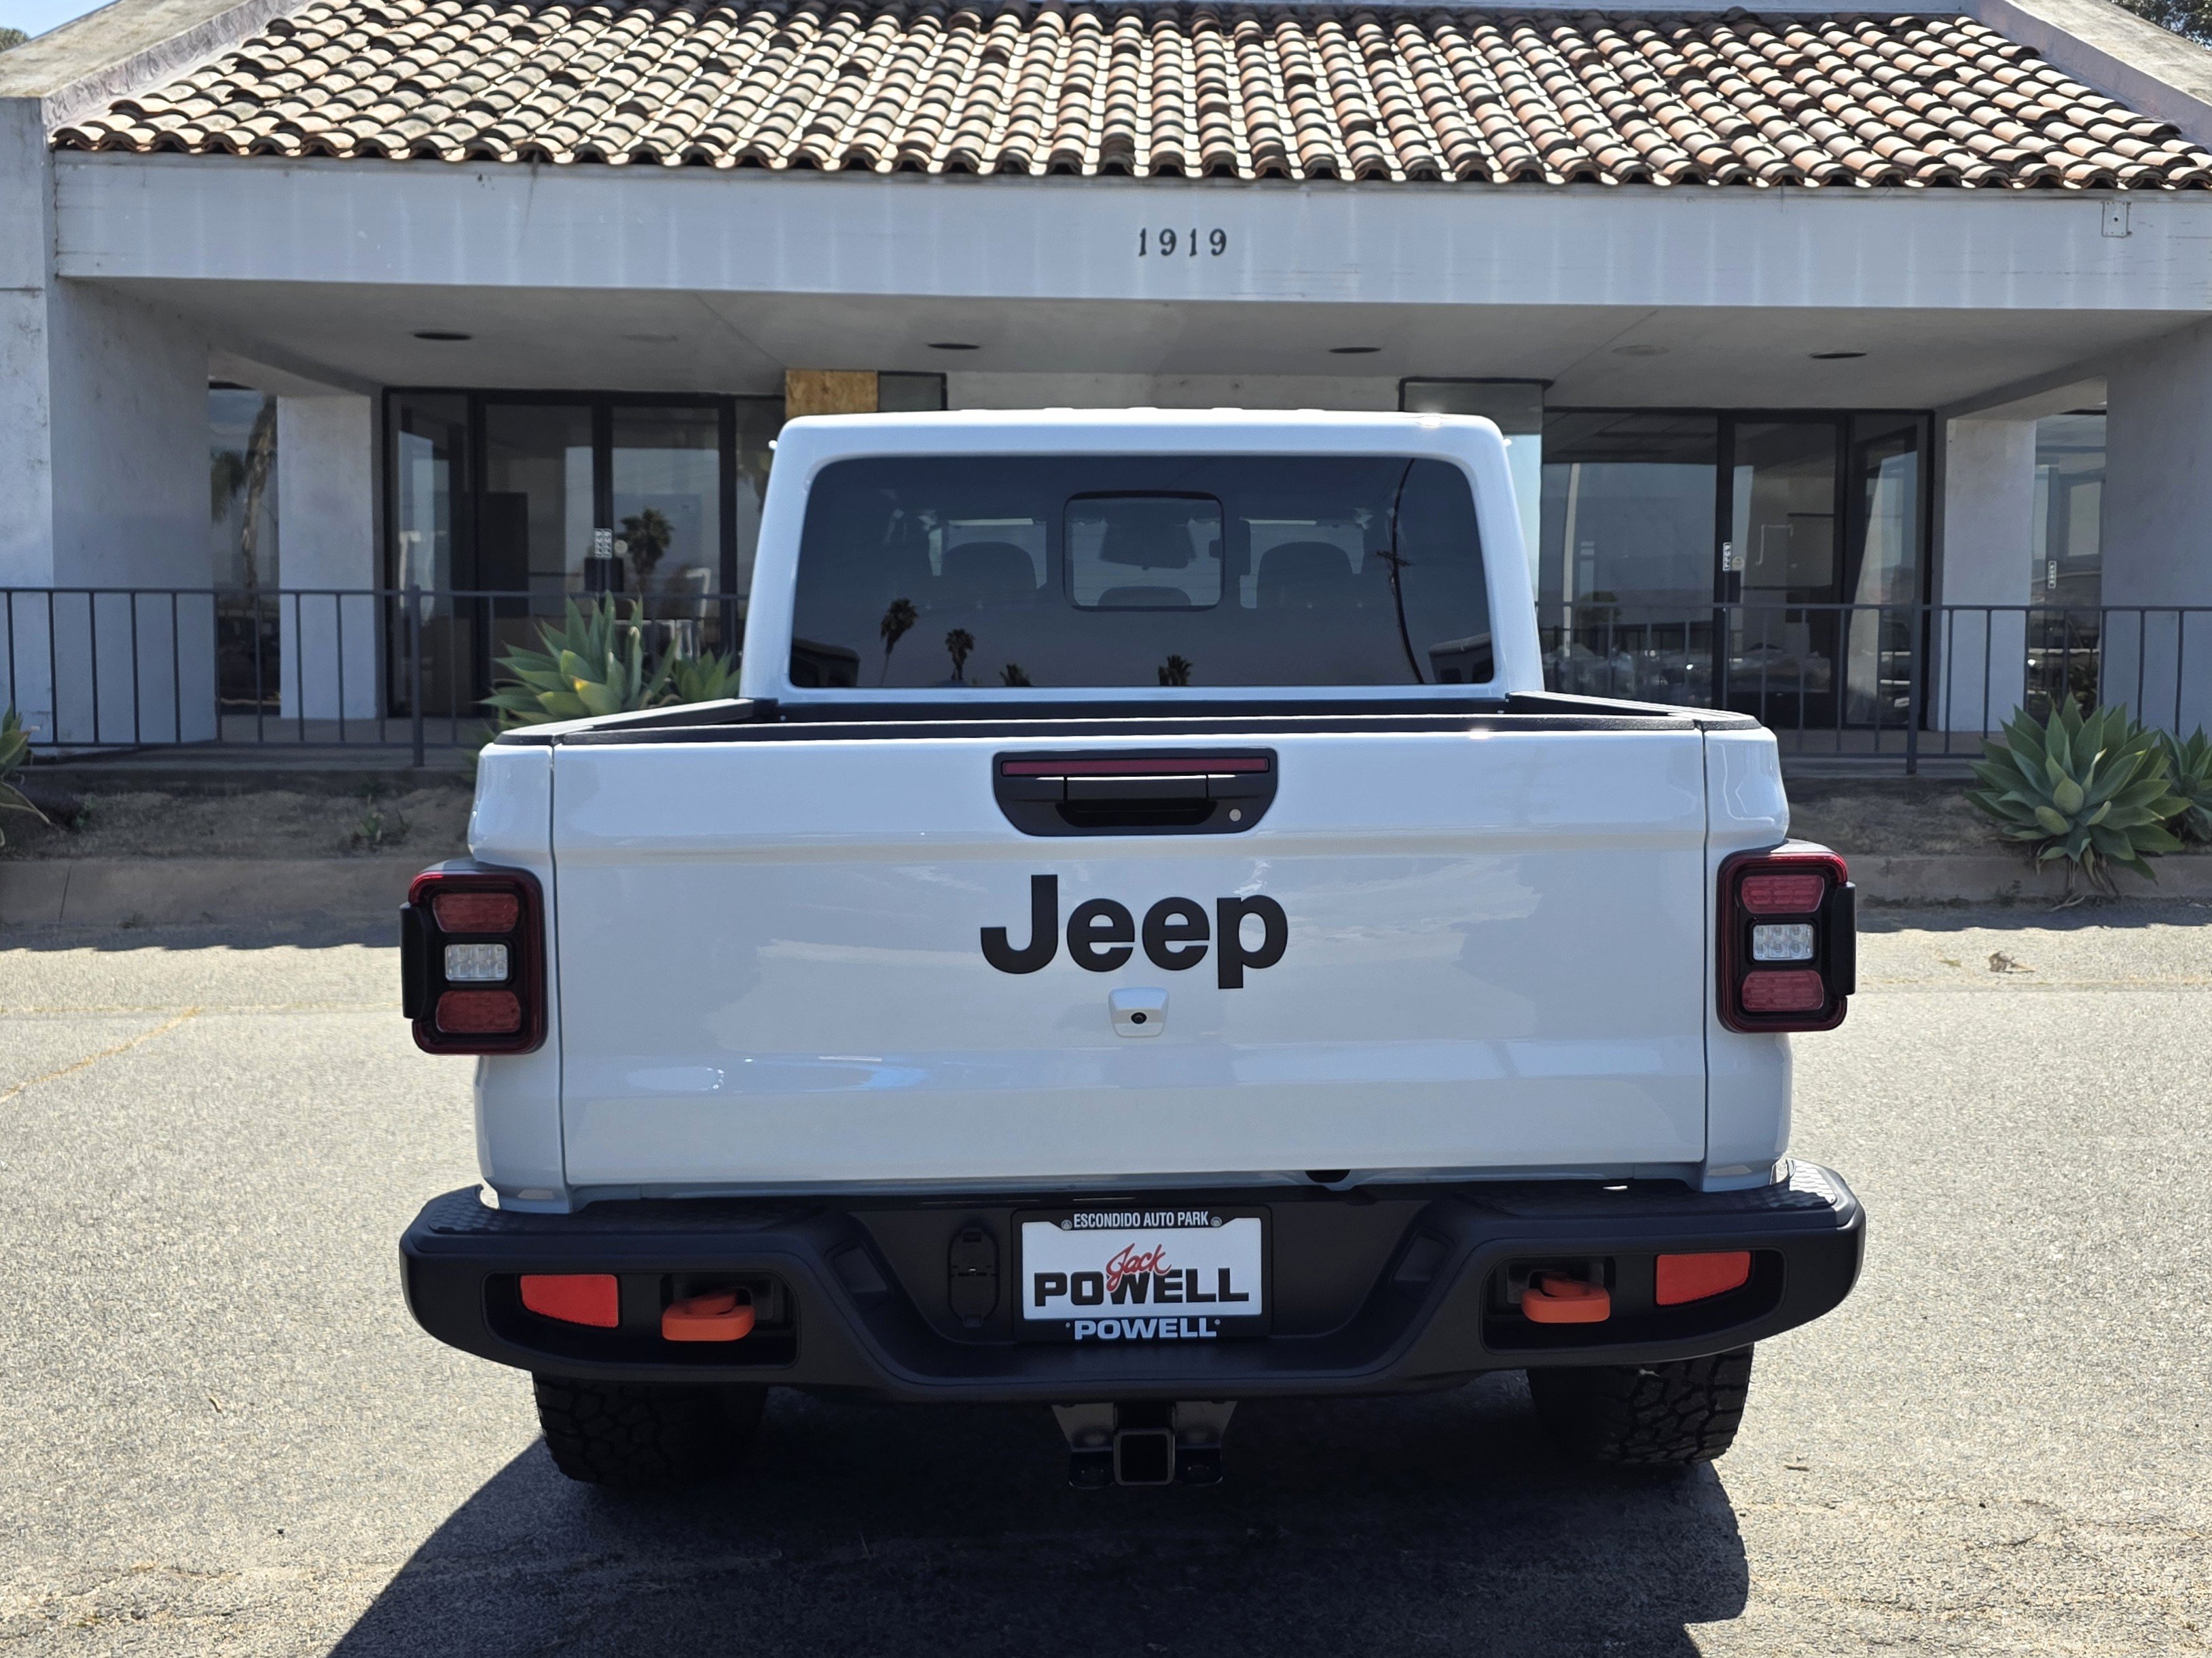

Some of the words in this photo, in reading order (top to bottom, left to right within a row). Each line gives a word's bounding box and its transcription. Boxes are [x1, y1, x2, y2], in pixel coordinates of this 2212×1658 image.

[1138, 227, 1227, 257] 1919
[980, 874, 1289, 990] Jeep
[1073, 1213, 1140, 1228] ESCONDIDO
[1143, 1211, 1176, 1227] AUTO
[1177, 1211, 1209, 1226] PARK
[1106, 1242, 1172, 1292] Jack
[1034, 1268, 1249, 1306] POWELL
[1074, 1318, 1217, 1340] POWELL
